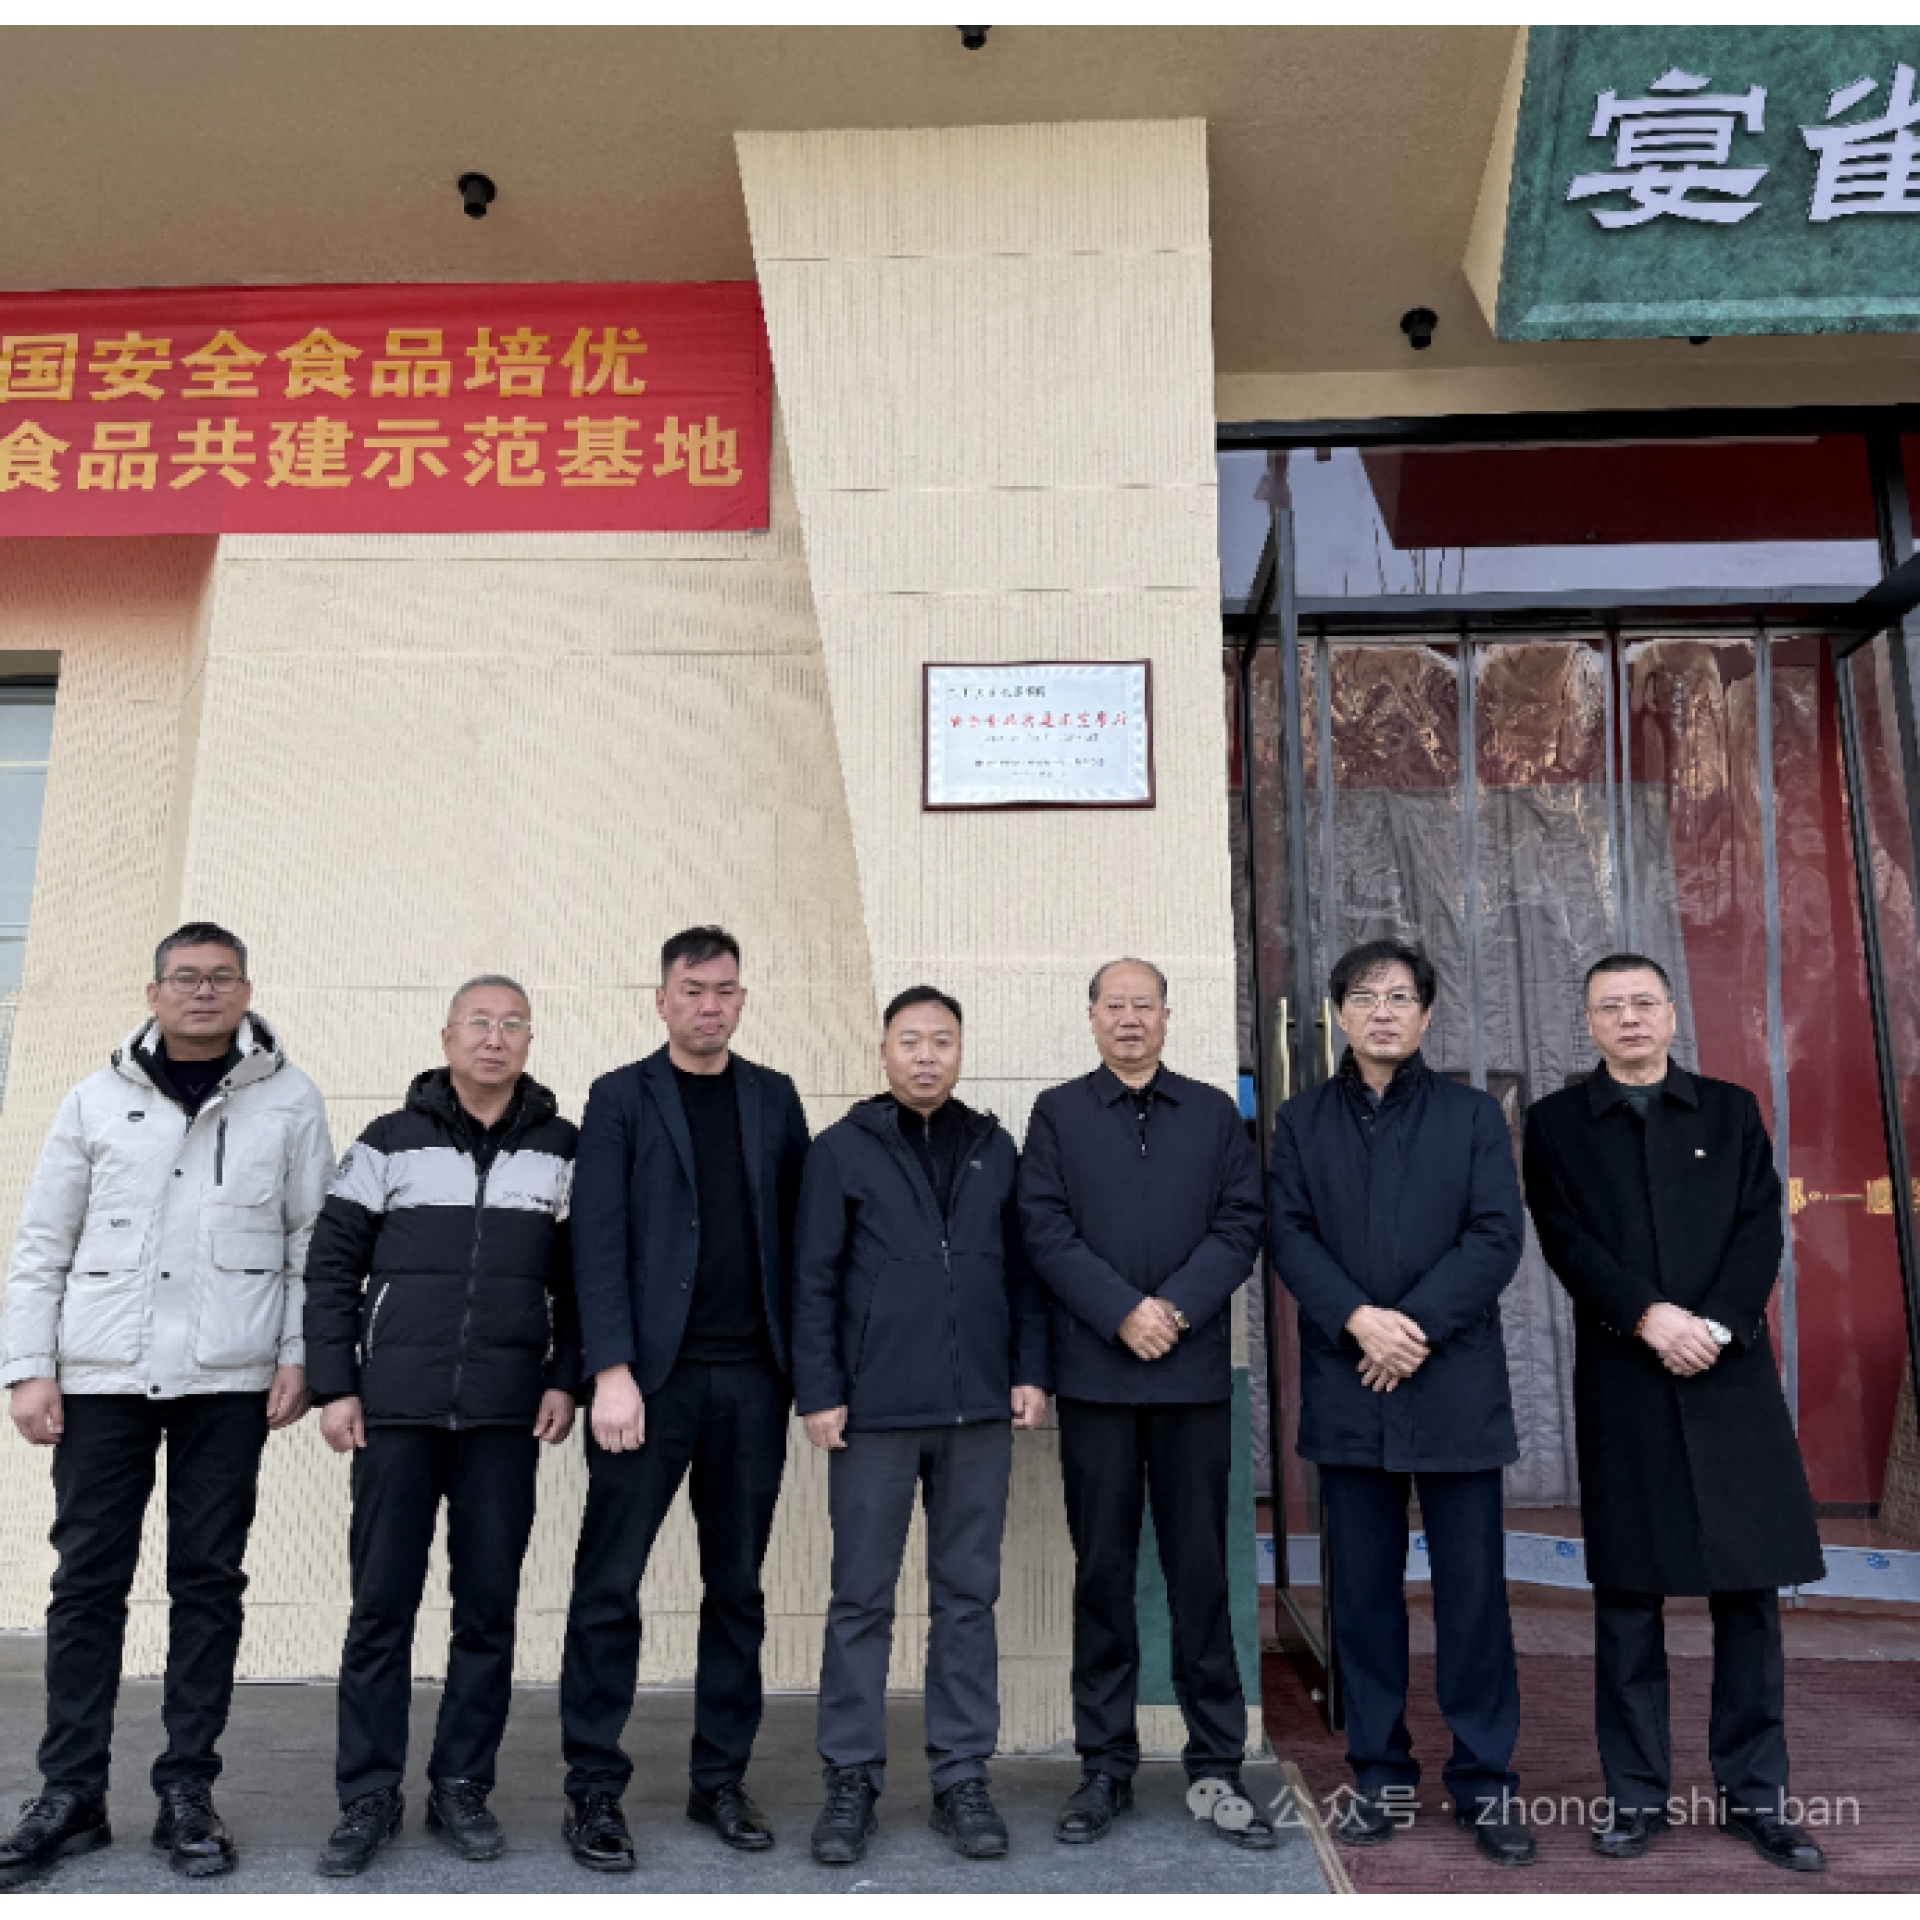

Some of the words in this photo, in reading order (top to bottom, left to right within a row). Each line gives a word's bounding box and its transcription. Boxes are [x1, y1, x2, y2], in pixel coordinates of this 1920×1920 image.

[0, 327, 647, 402] 国安全食品培优
[0, 415, 743, 492] 食品共建示范基地
